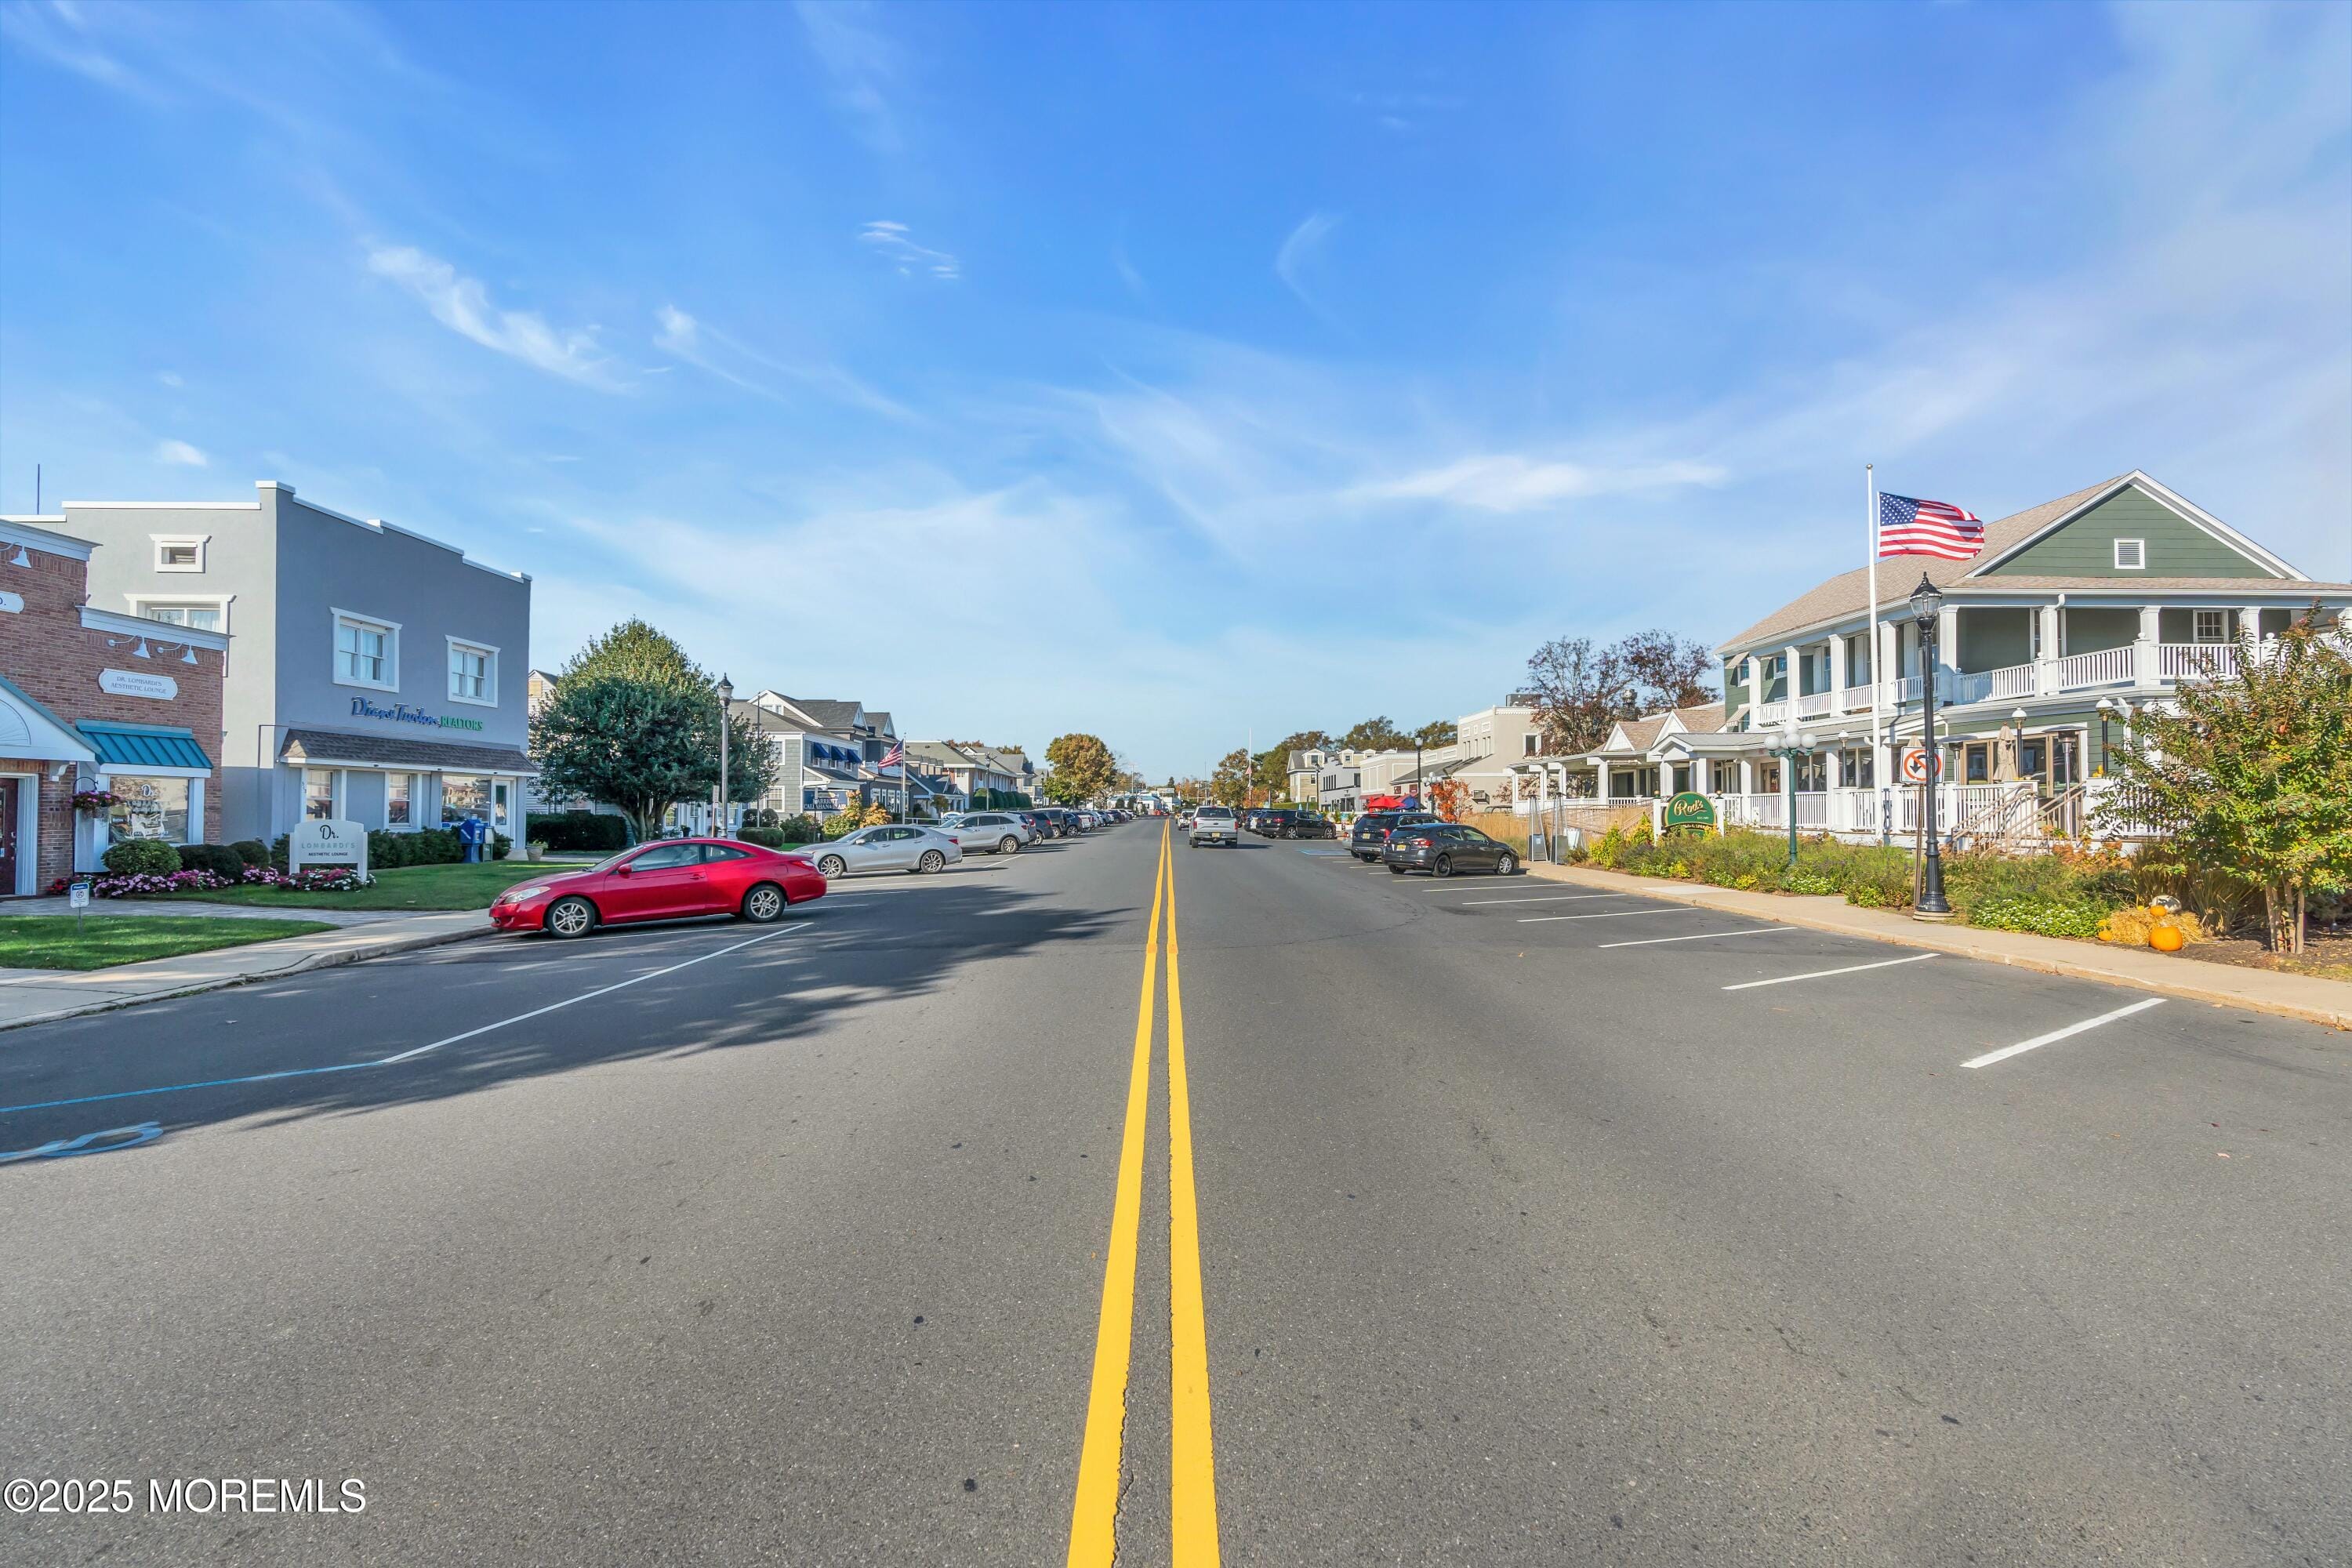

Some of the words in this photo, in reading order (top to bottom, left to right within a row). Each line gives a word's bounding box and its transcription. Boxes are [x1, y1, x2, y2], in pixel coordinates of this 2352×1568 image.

[111, 682, 143, 691] AESTHETIC
[143, 685, 167, 695] LOUNGE
[351, 695, 394, 720] Diane
[441, 715, 483, 731] REALTORS
[1673, 799, 1707, 817] Rod's
[319, 824, 339, 840] Dr.
